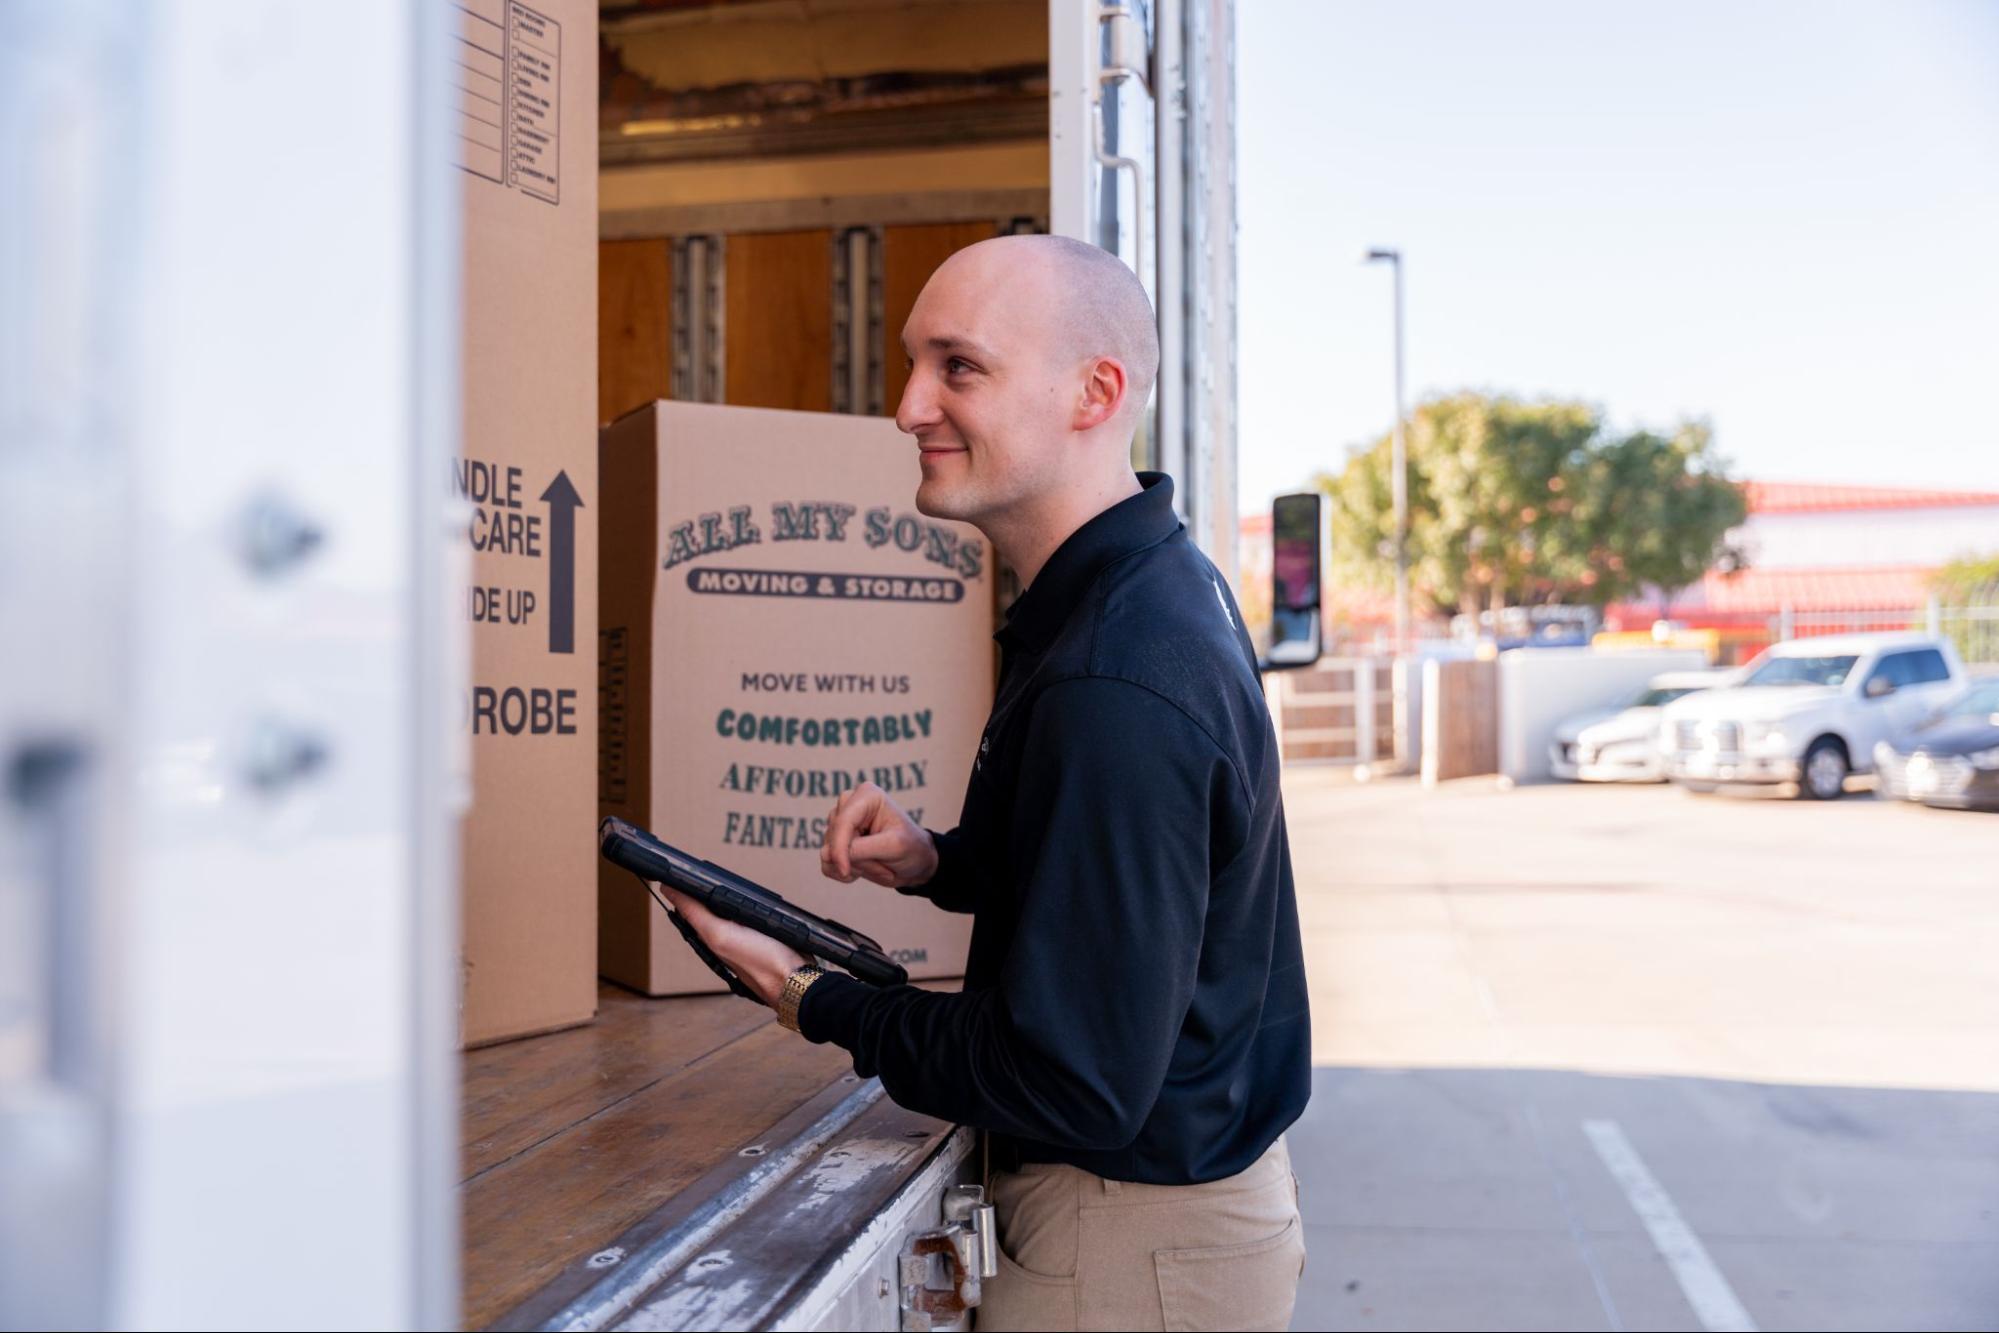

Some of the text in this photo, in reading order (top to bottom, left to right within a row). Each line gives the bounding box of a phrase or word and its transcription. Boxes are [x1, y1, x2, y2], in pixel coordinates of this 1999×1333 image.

[469, 507, 541, 558] CARE
[663, 502, 983, 578] ALL MY SONS
[698, 573, 956, 600] MOVING & STORAGE
[507, 589, 535, 625] UP
[741, 673, 911, 694] MOVE WITH US
[467, 686, 577, 736] ROBE
[716, 708, 932, 746] COMFORTABLY
